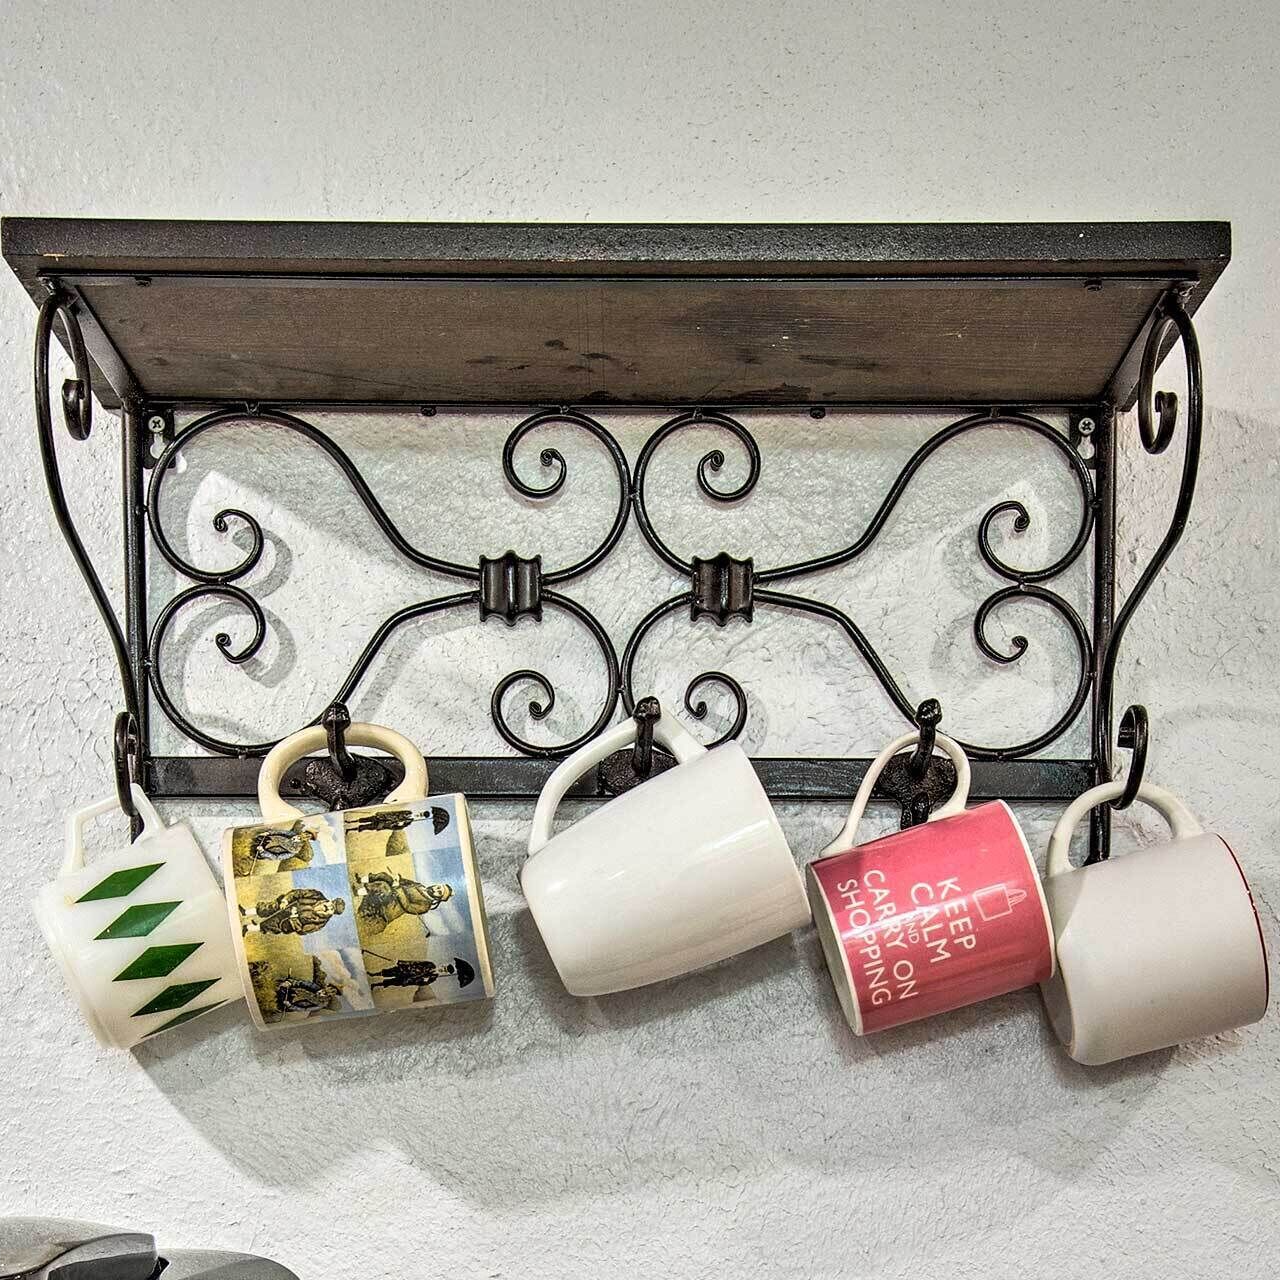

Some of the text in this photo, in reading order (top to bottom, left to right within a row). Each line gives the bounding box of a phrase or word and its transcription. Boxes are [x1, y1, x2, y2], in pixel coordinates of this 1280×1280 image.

[836, 879, 892, 1005] SHOPPING
[863, 869, 919, 1000] CARRY ON
[910, 882, 952, 964] CALM
[936, 877, 976, 950] KEEP
